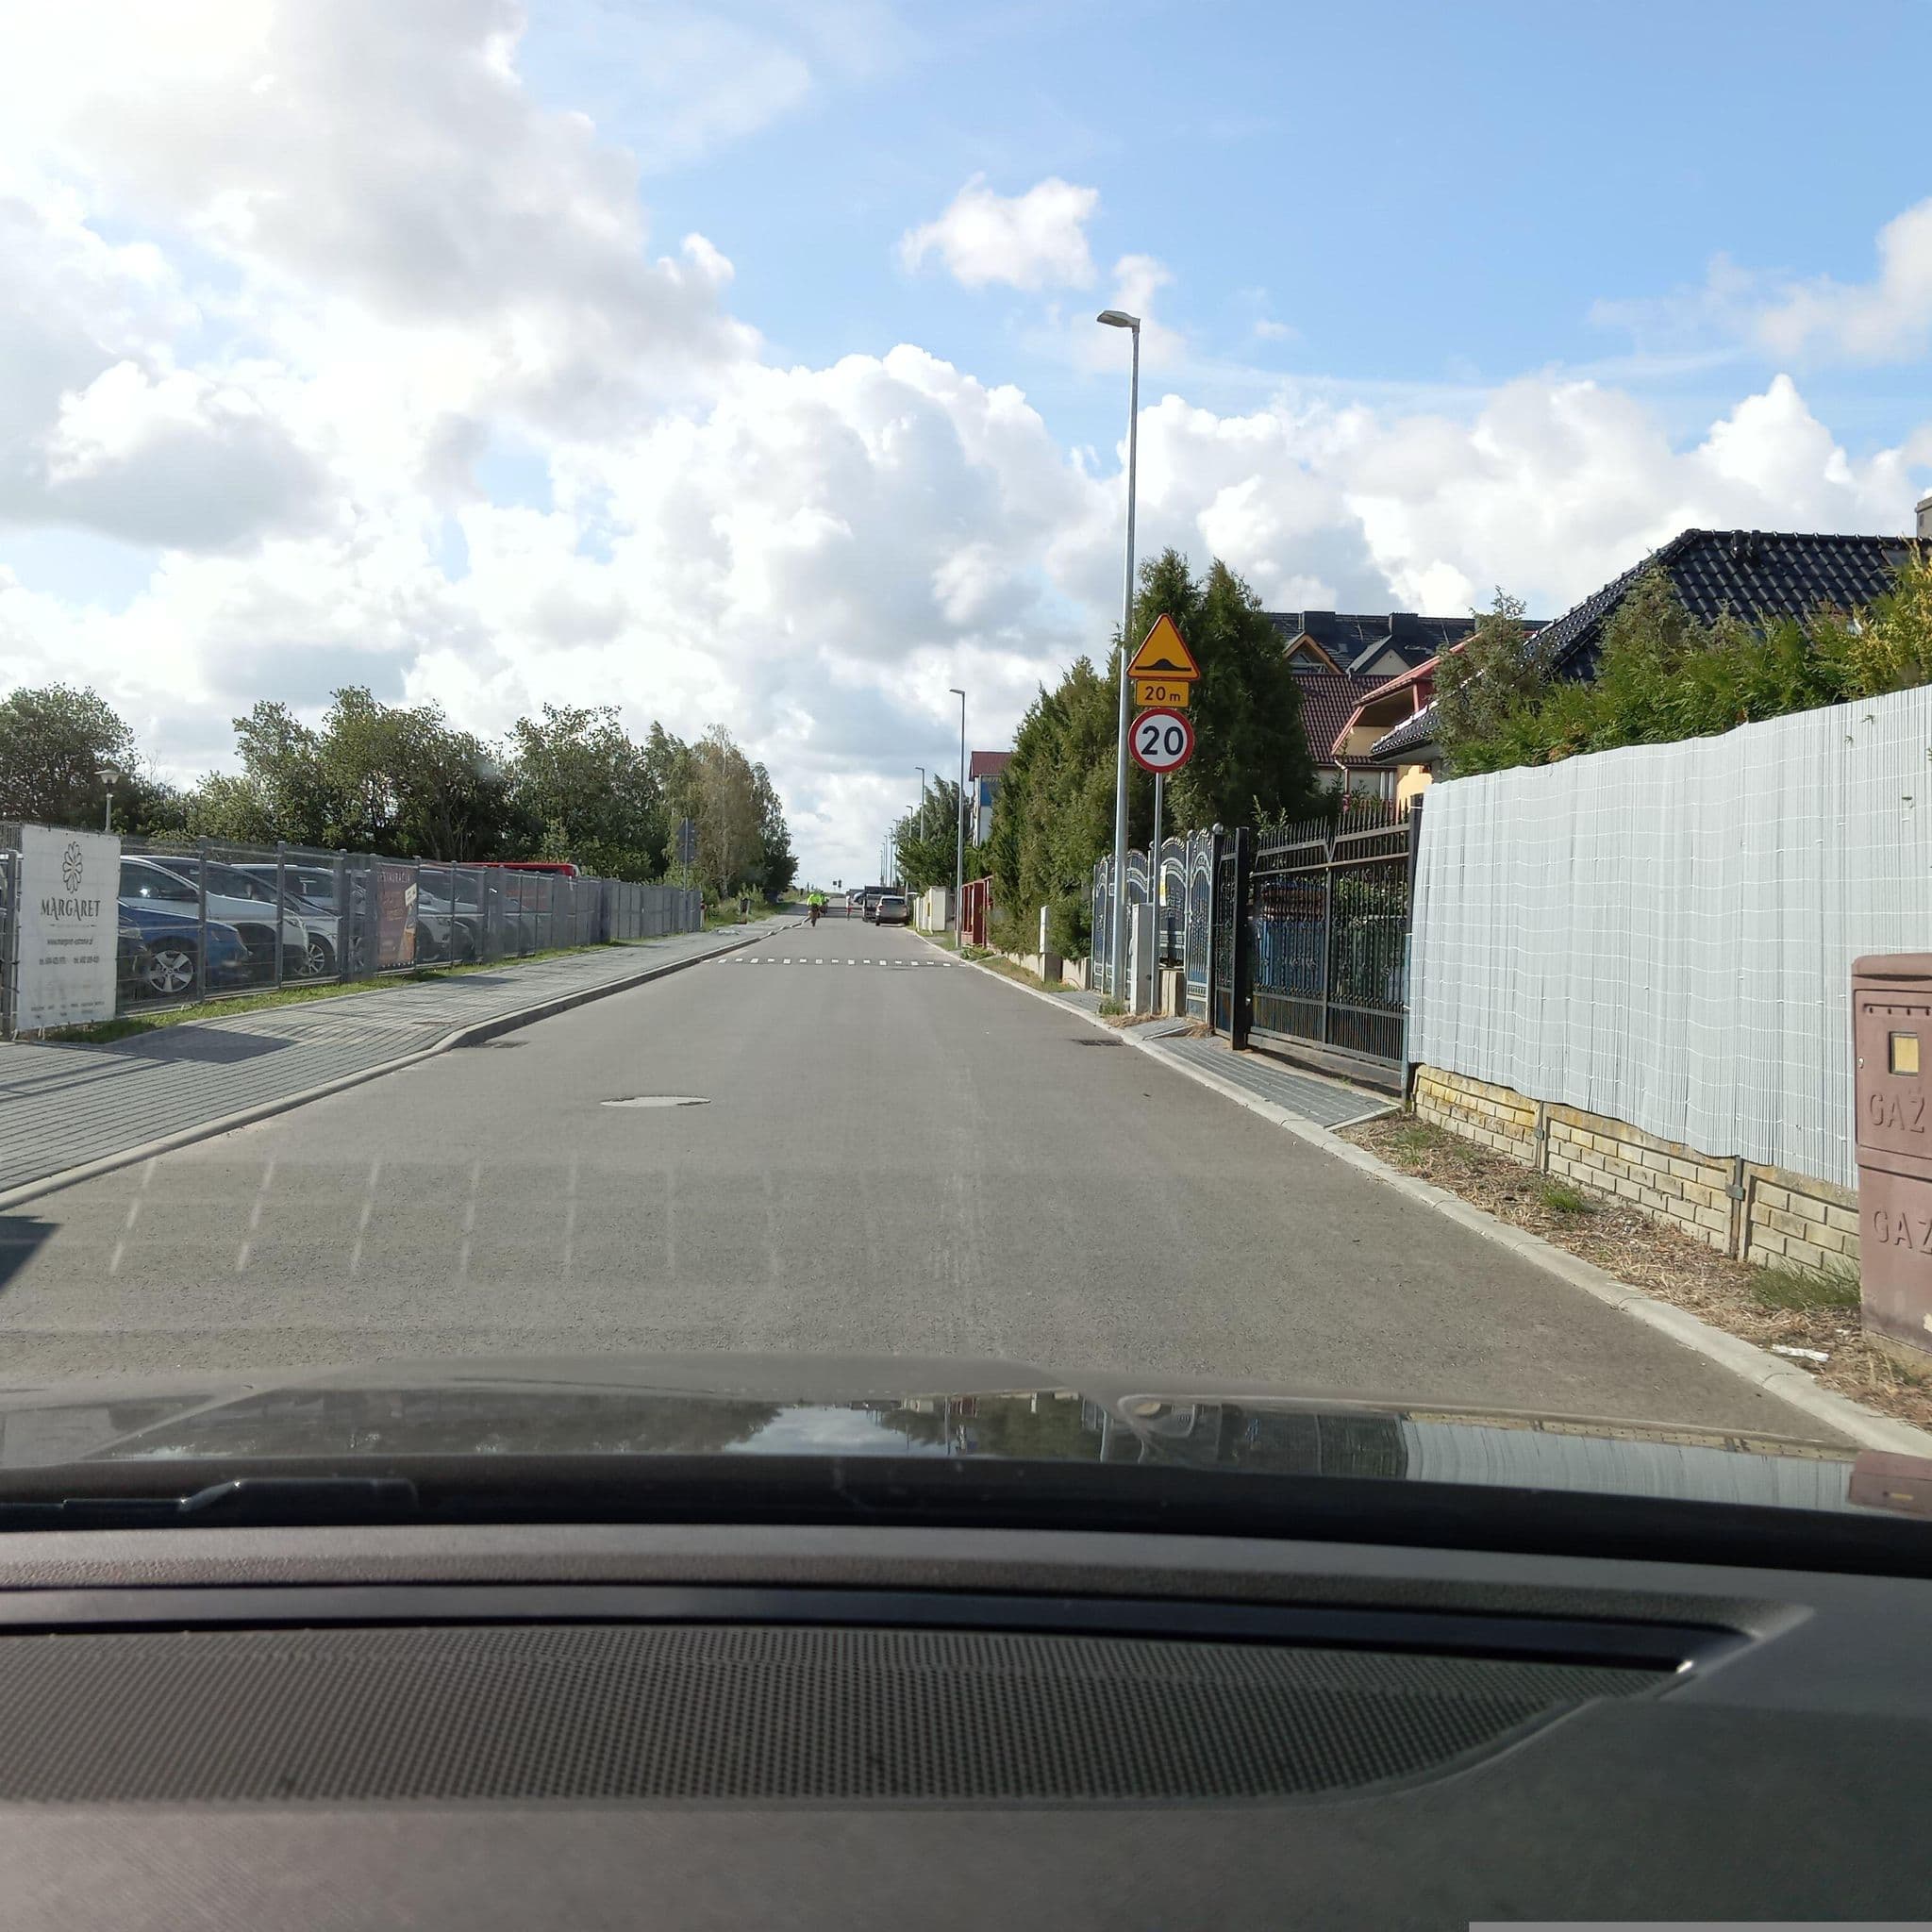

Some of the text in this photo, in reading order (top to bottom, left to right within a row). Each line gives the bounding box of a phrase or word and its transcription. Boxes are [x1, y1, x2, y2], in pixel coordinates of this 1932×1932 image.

[1144, 686, 1166, 701] 20
[1141, 725, 1183, 756] 20
[41, 898, 101, 921] MARGARET
[1870, 1093, 1925, 1133] GAZ
